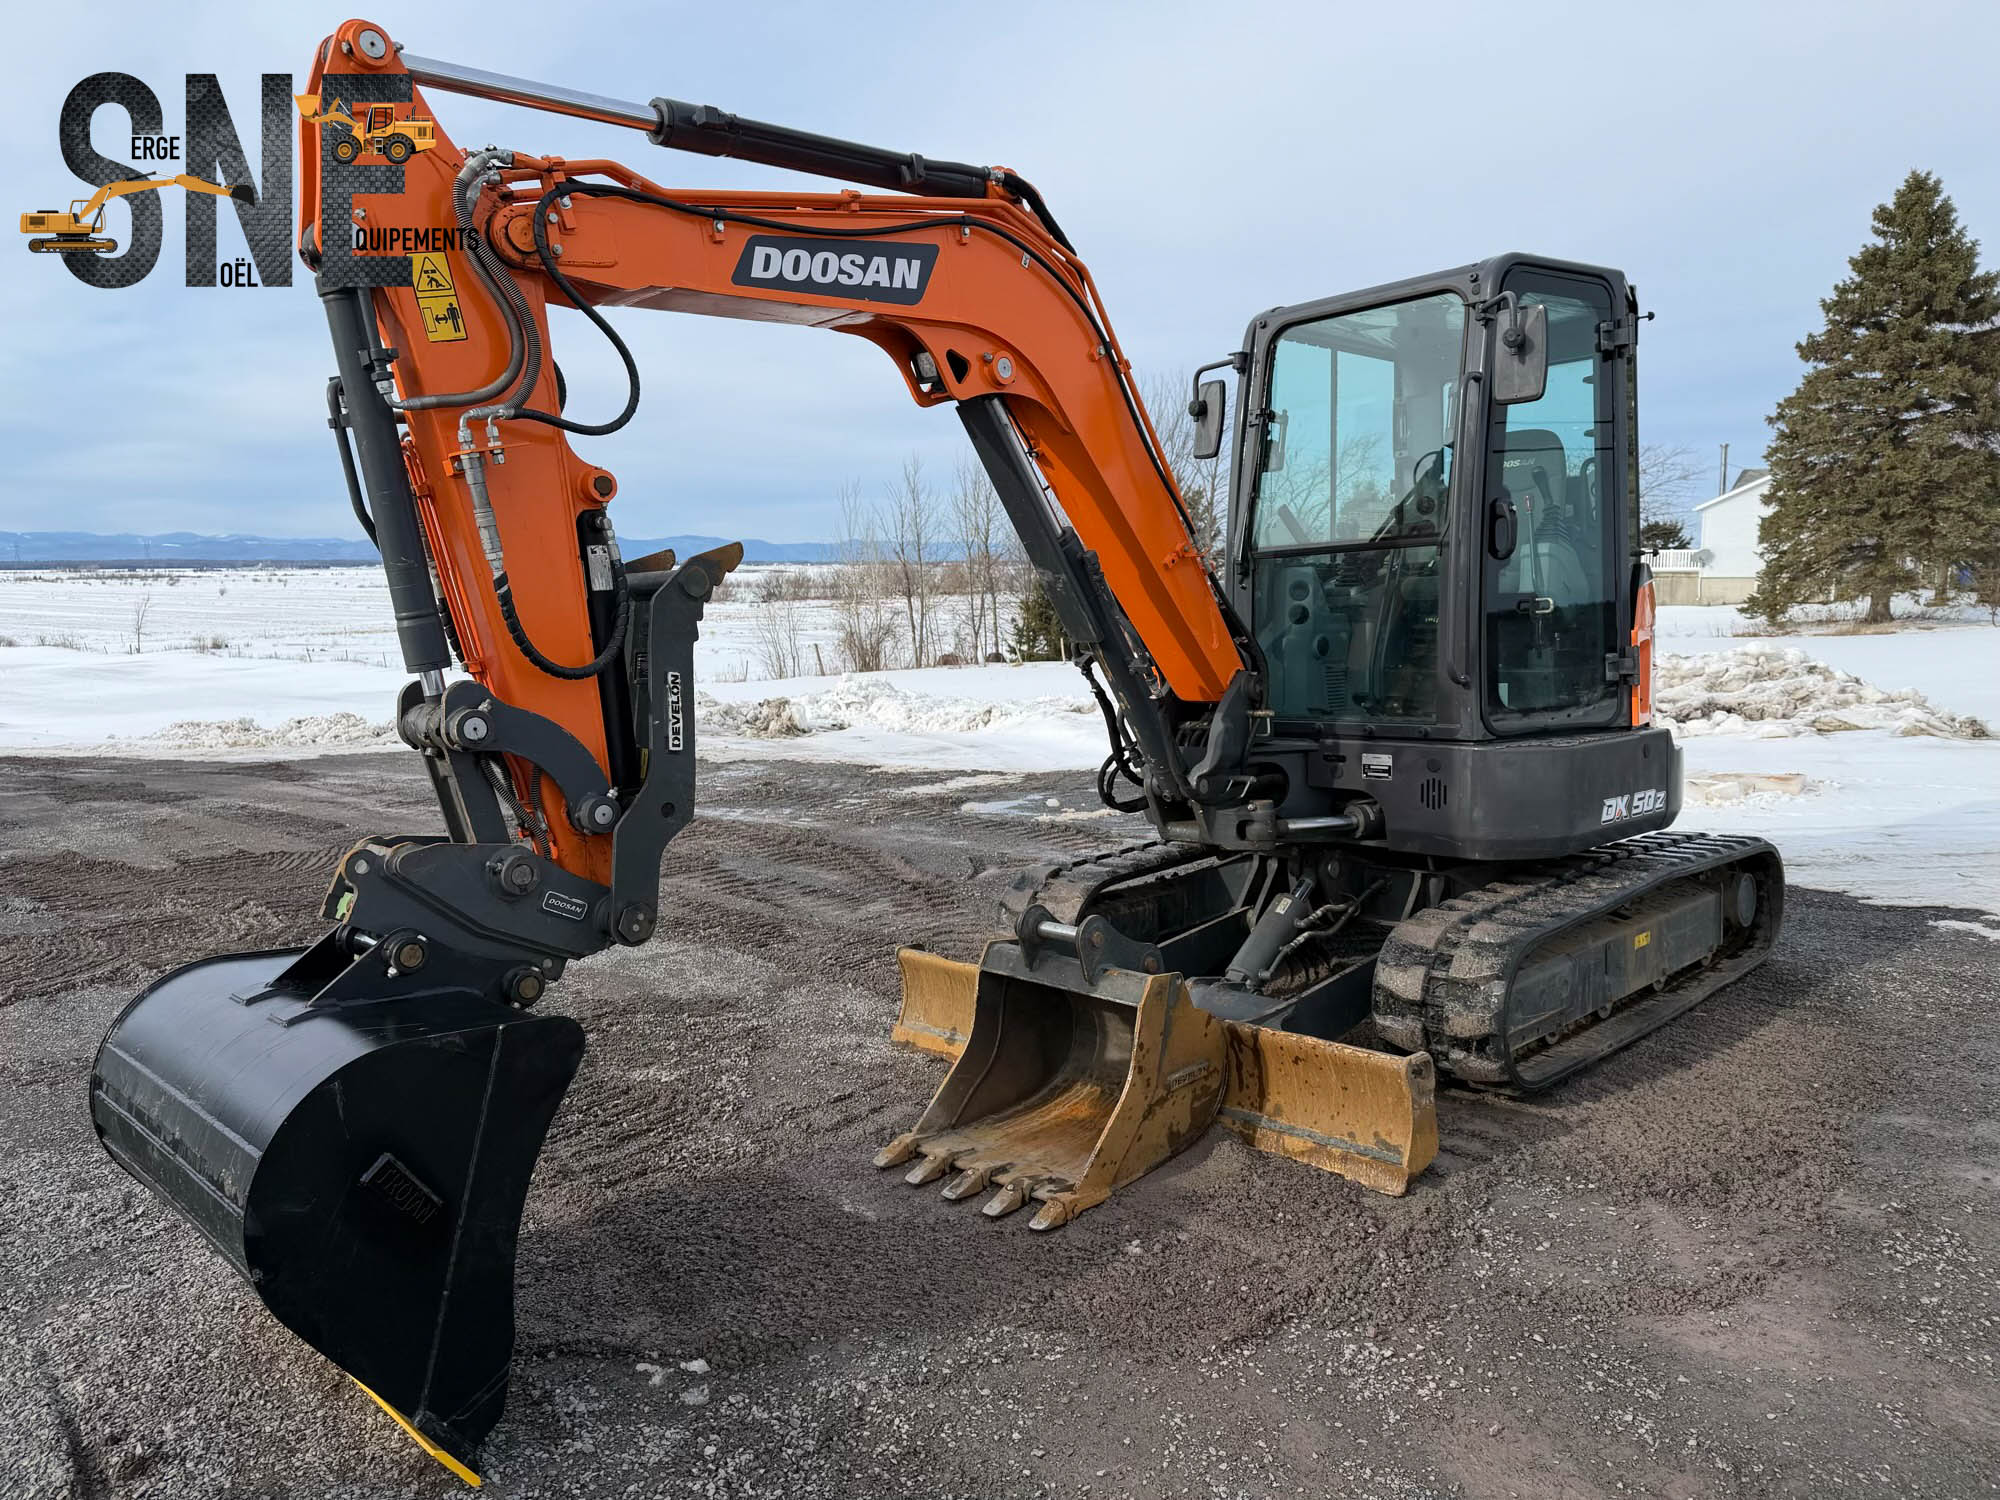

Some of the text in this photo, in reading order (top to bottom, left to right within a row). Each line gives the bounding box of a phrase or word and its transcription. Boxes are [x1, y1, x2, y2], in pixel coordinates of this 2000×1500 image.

[751, 246, 921, 289] DOOSAN
[671, 674, 681, 748] DEVELON
[548, 898, 582, 913] DOOSAN
[376, 1165, 439, 1224] TROJAN
